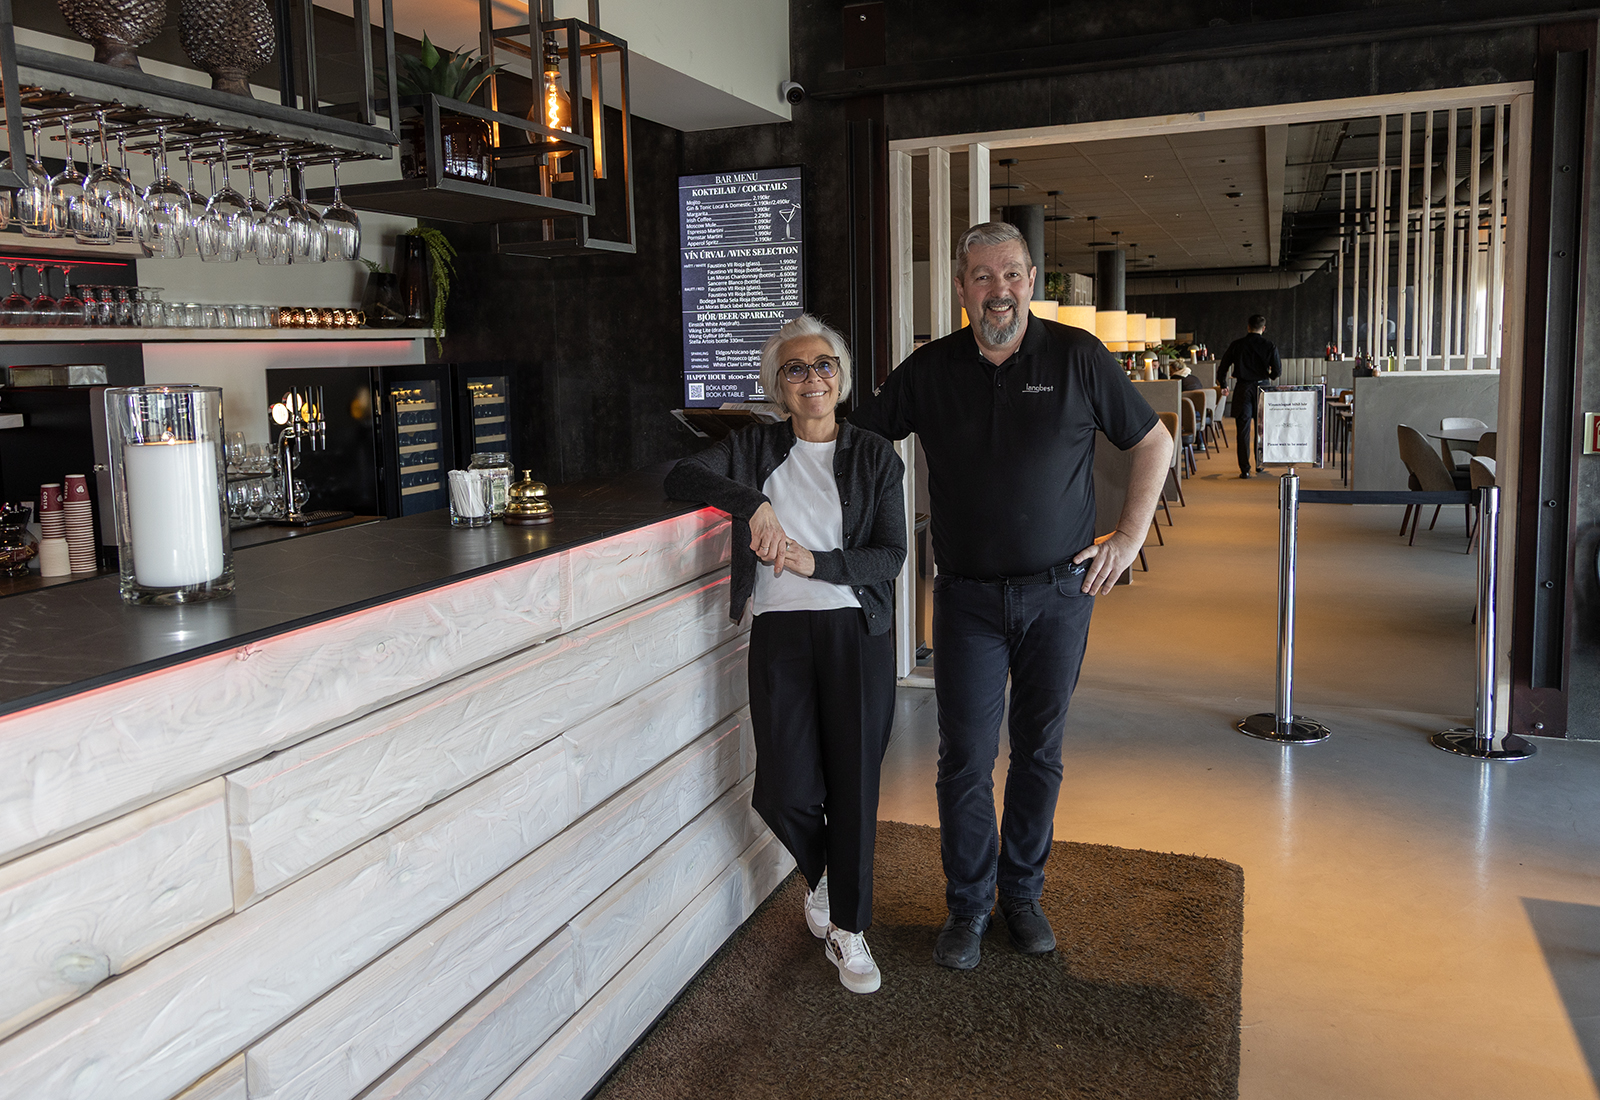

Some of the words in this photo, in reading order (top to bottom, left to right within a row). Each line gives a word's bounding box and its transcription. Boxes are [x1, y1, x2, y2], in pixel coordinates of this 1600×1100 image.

[716, 176, 732, 184] BAR
[734, 172, 758, 182] MENU
[692, 186, 736, 196] KOKTEILAR
[742, 182, 788, 192] COCKTAILS
[684, 250, 698, 260] VÍN
[700, 250, 726, 258] ÚRVAL
[752, 246, 798, 256] SELECTION
[730, 272, 758, 280] Chardonnay
[1026, 383, 1054, 393] langbest
